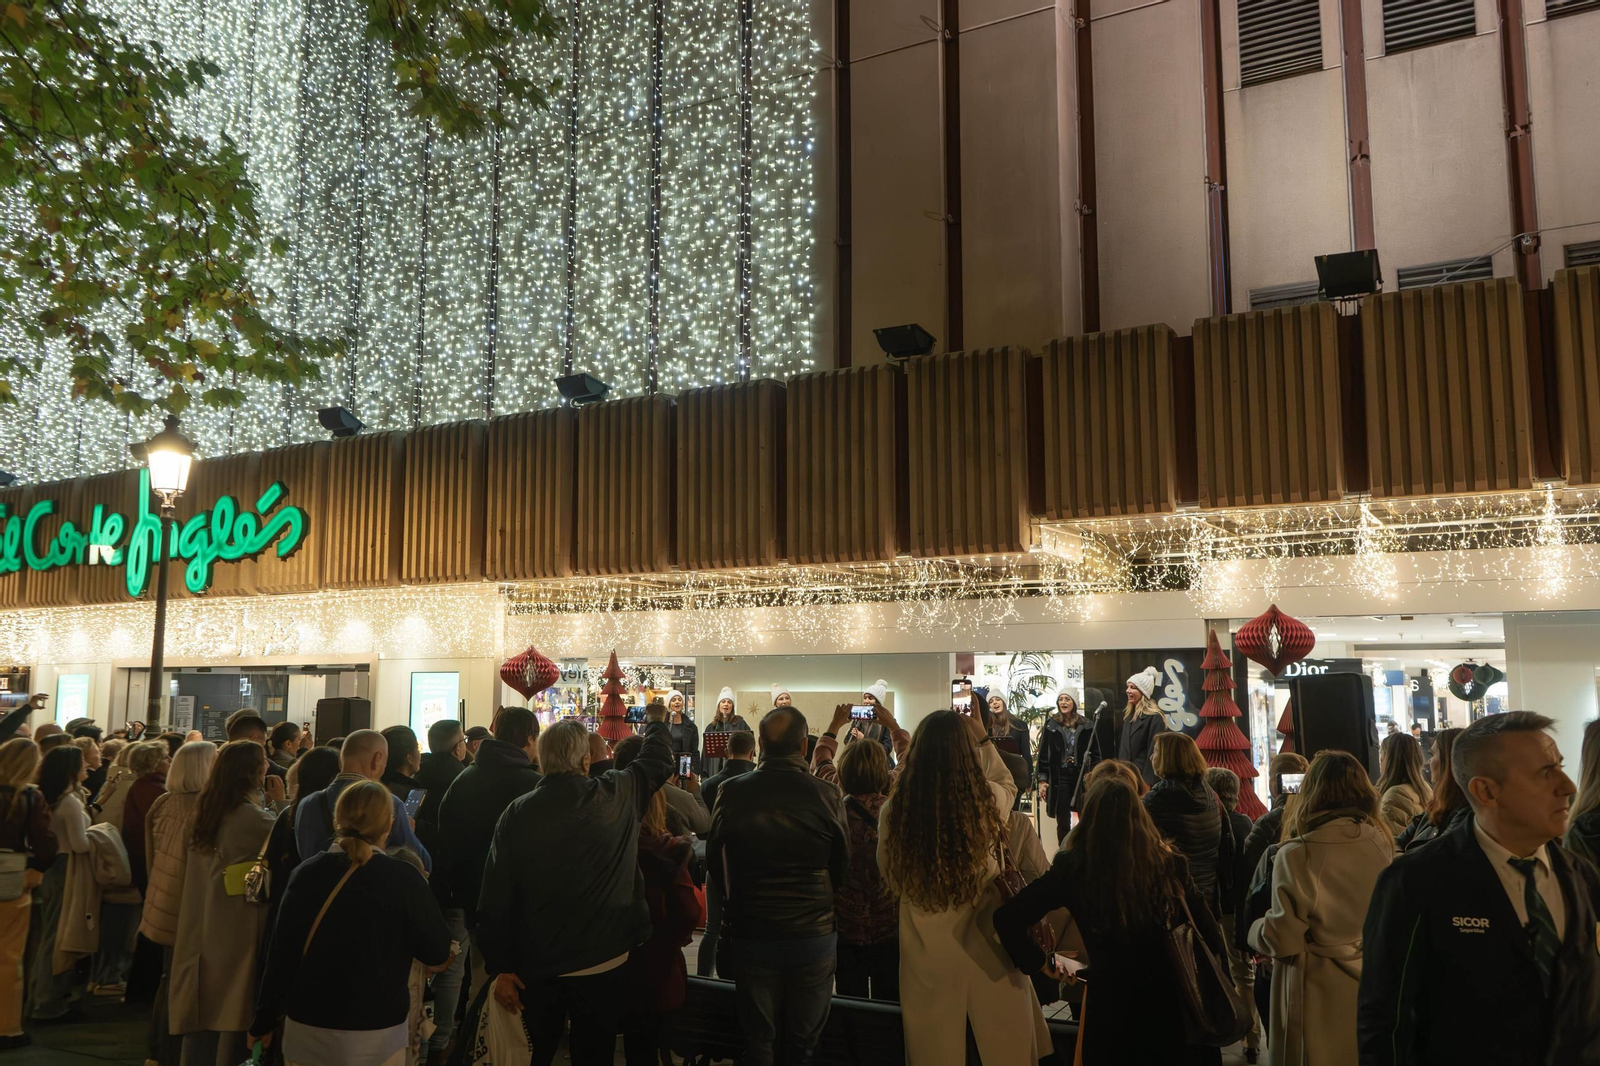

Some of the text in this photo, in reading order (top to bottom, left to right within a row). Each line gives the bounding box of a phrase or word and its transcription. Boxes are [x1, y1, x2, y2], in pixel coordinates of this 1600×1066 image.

[23, 499, 123, 572] Corte
[126, 467, 303, 597] Inglés
[1284, 661, 1329, 677] Dior
[1452, 916, 1490, 928] SICOR
